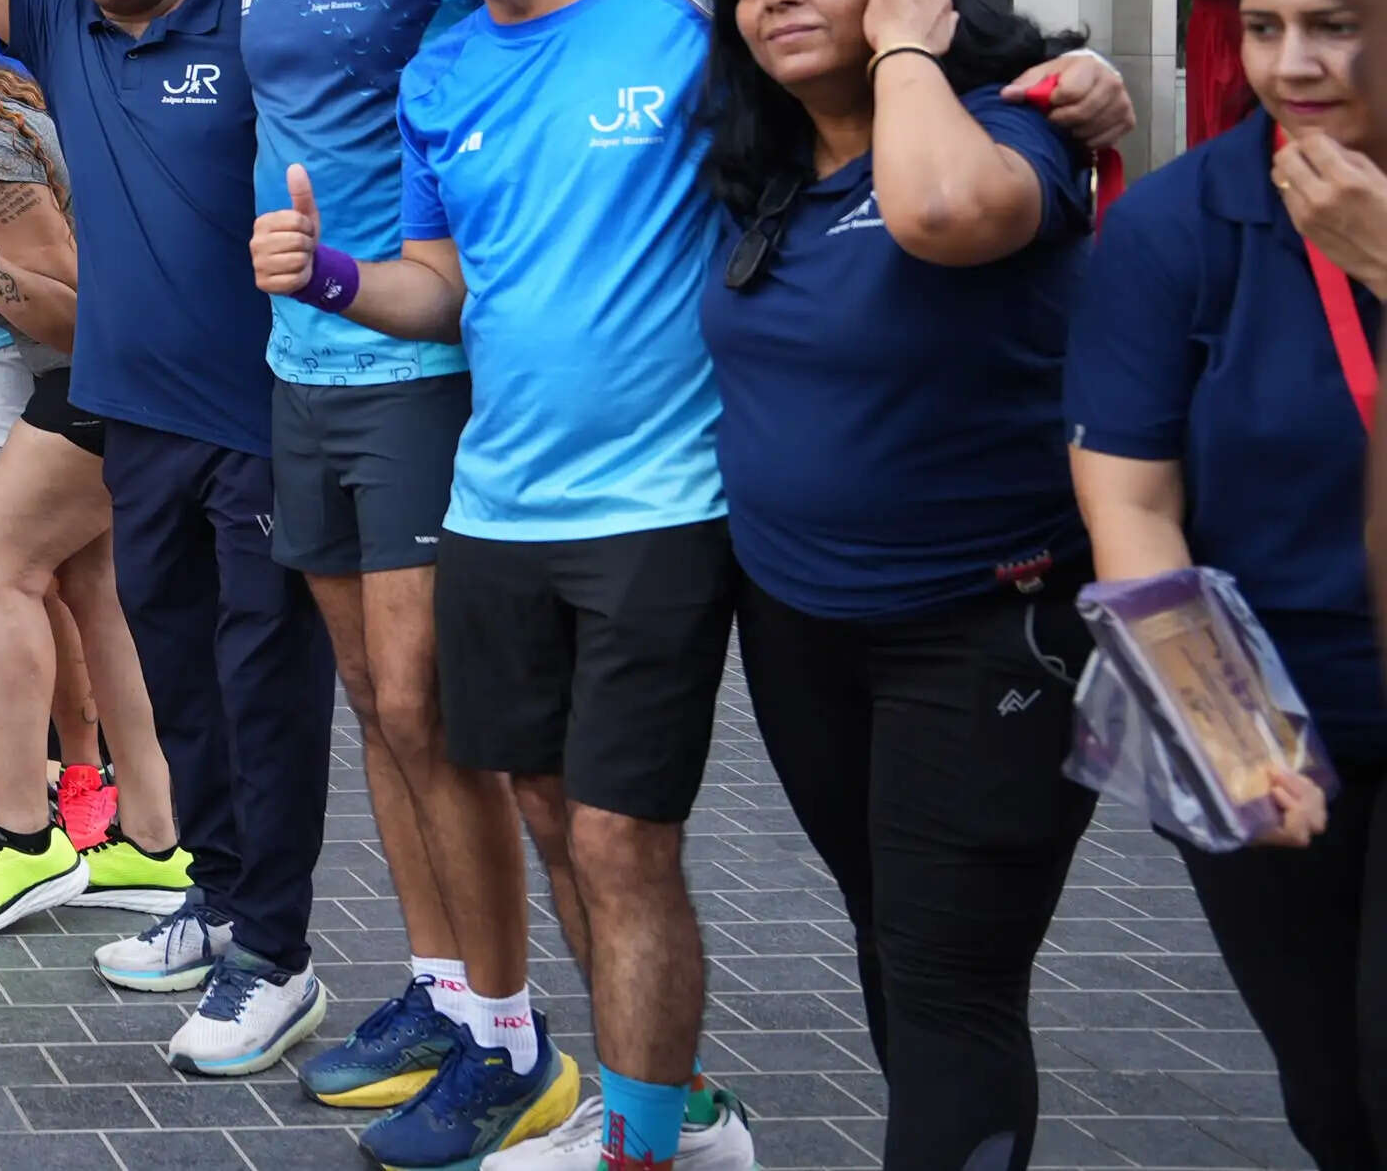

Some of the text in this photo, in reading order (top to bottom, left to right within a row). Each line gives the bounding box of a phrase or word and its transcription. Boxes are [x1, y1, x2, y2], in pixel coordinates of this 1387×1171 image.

[163, 64, 221, 95] JR
[161, 96, 217, 105] Jaipur Runners
[589, 86, 665, 133] JR
